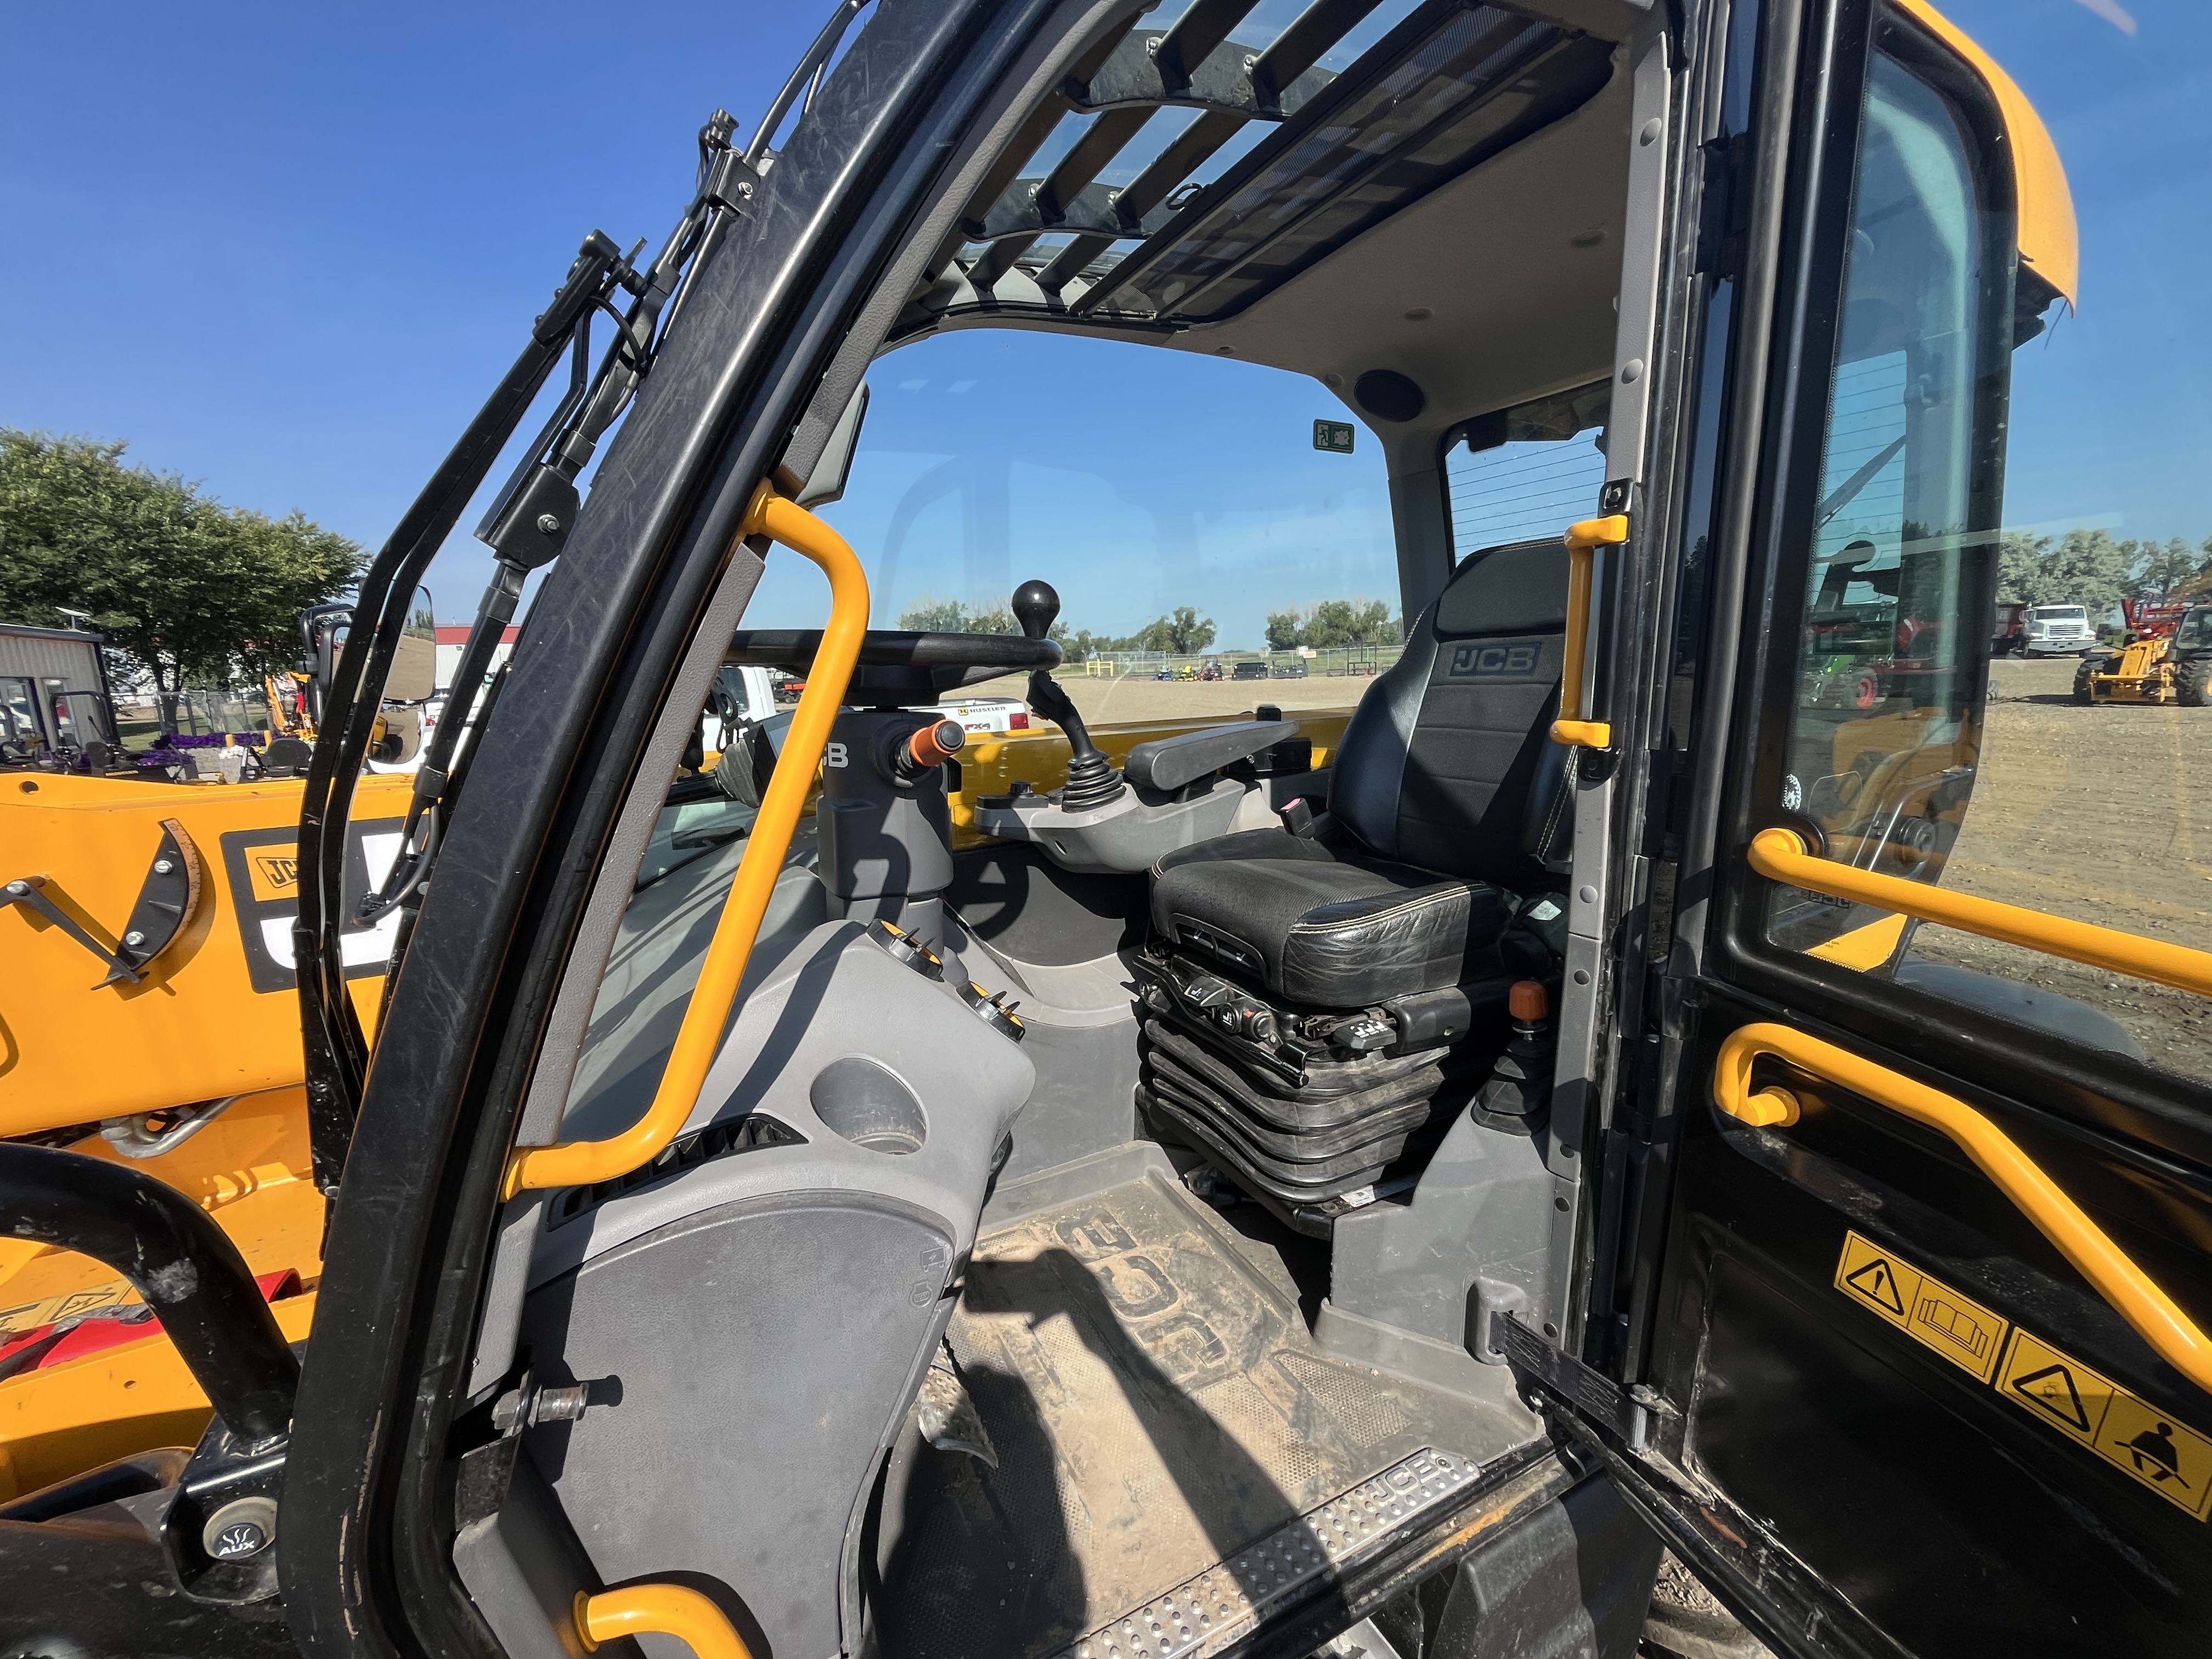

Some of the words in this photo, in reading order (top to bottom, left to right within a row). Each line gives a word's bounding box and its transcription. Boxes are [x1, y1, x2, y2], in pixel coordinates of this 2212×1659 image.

[1454, 647, 1536, 673] JCB
[1364, 1455, 1440, 1504] JCB
[219, 1539, 255, 1556] AUX
